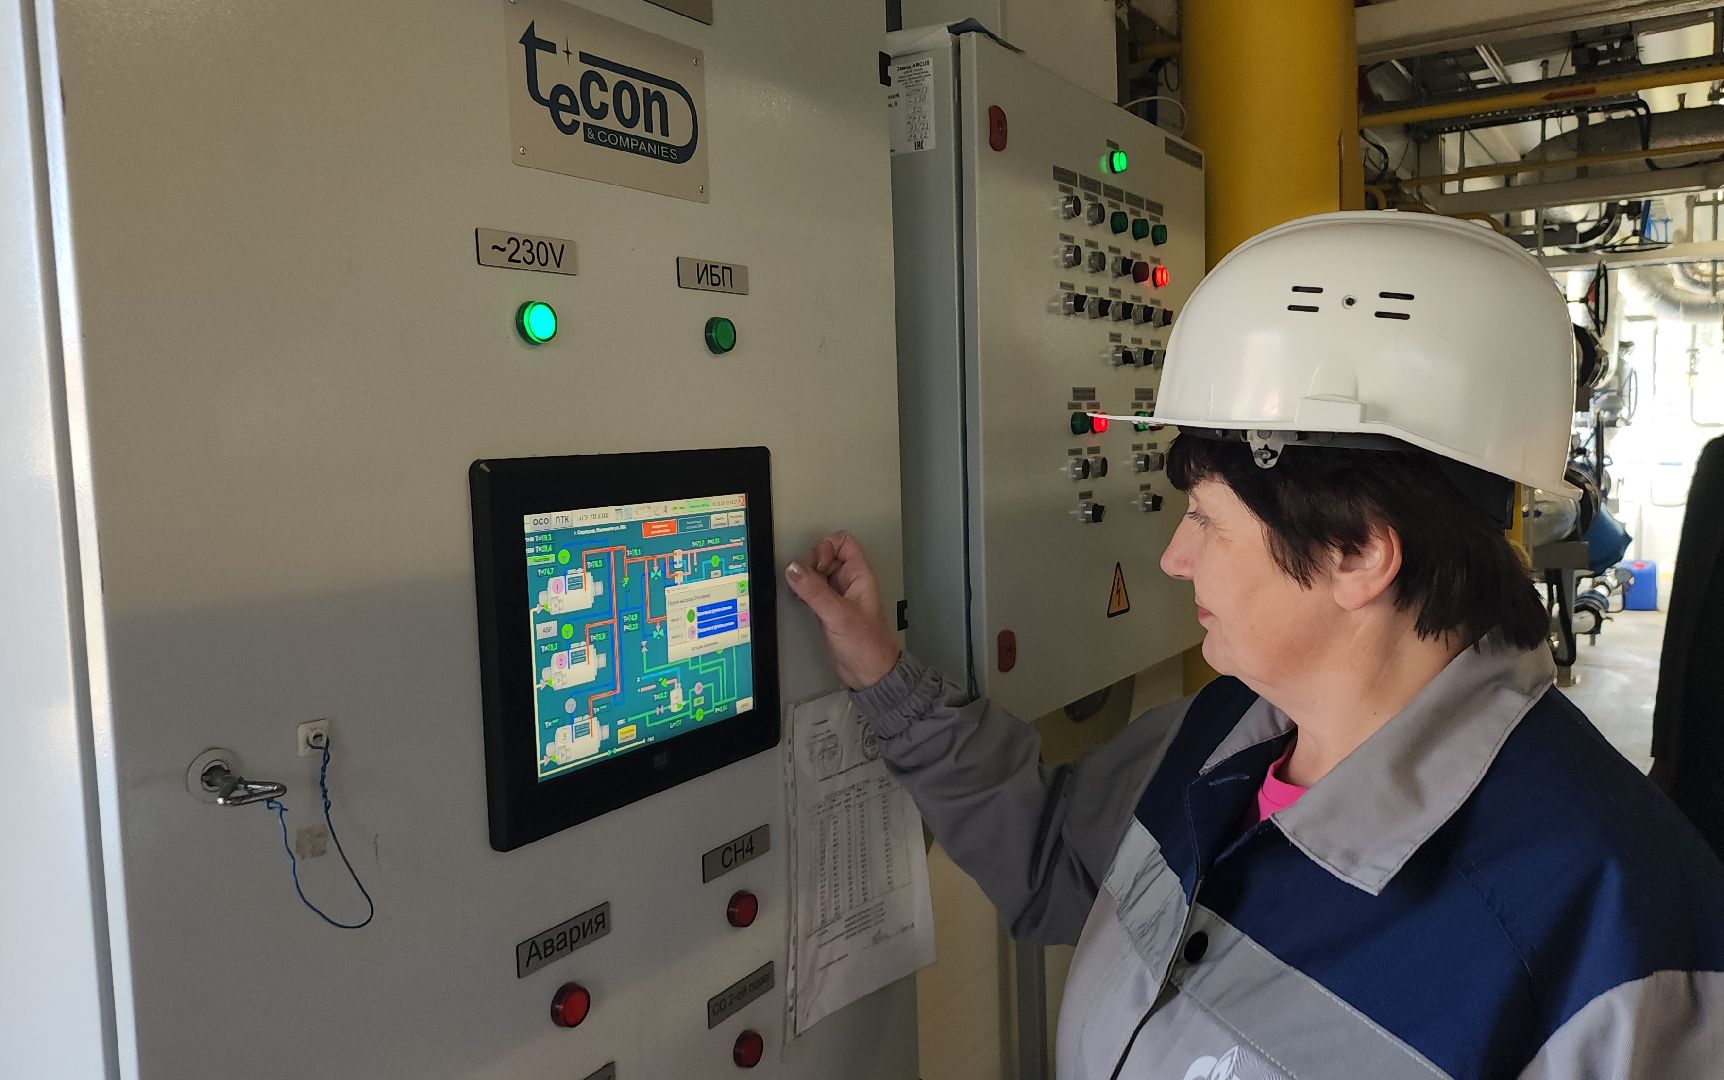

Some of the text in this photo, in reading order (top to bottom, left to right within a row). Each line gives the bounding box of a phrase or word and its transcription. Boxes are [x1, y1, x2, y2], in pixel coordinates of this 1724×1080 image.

[597, 131, 679, 160] COMPANIES
[491, 237, 566, 269] ~230V
[696, 263, 733, 289] ИБП
[555, 515, 570, 524] ПТК
[525, 909, 606, 968] Авария
